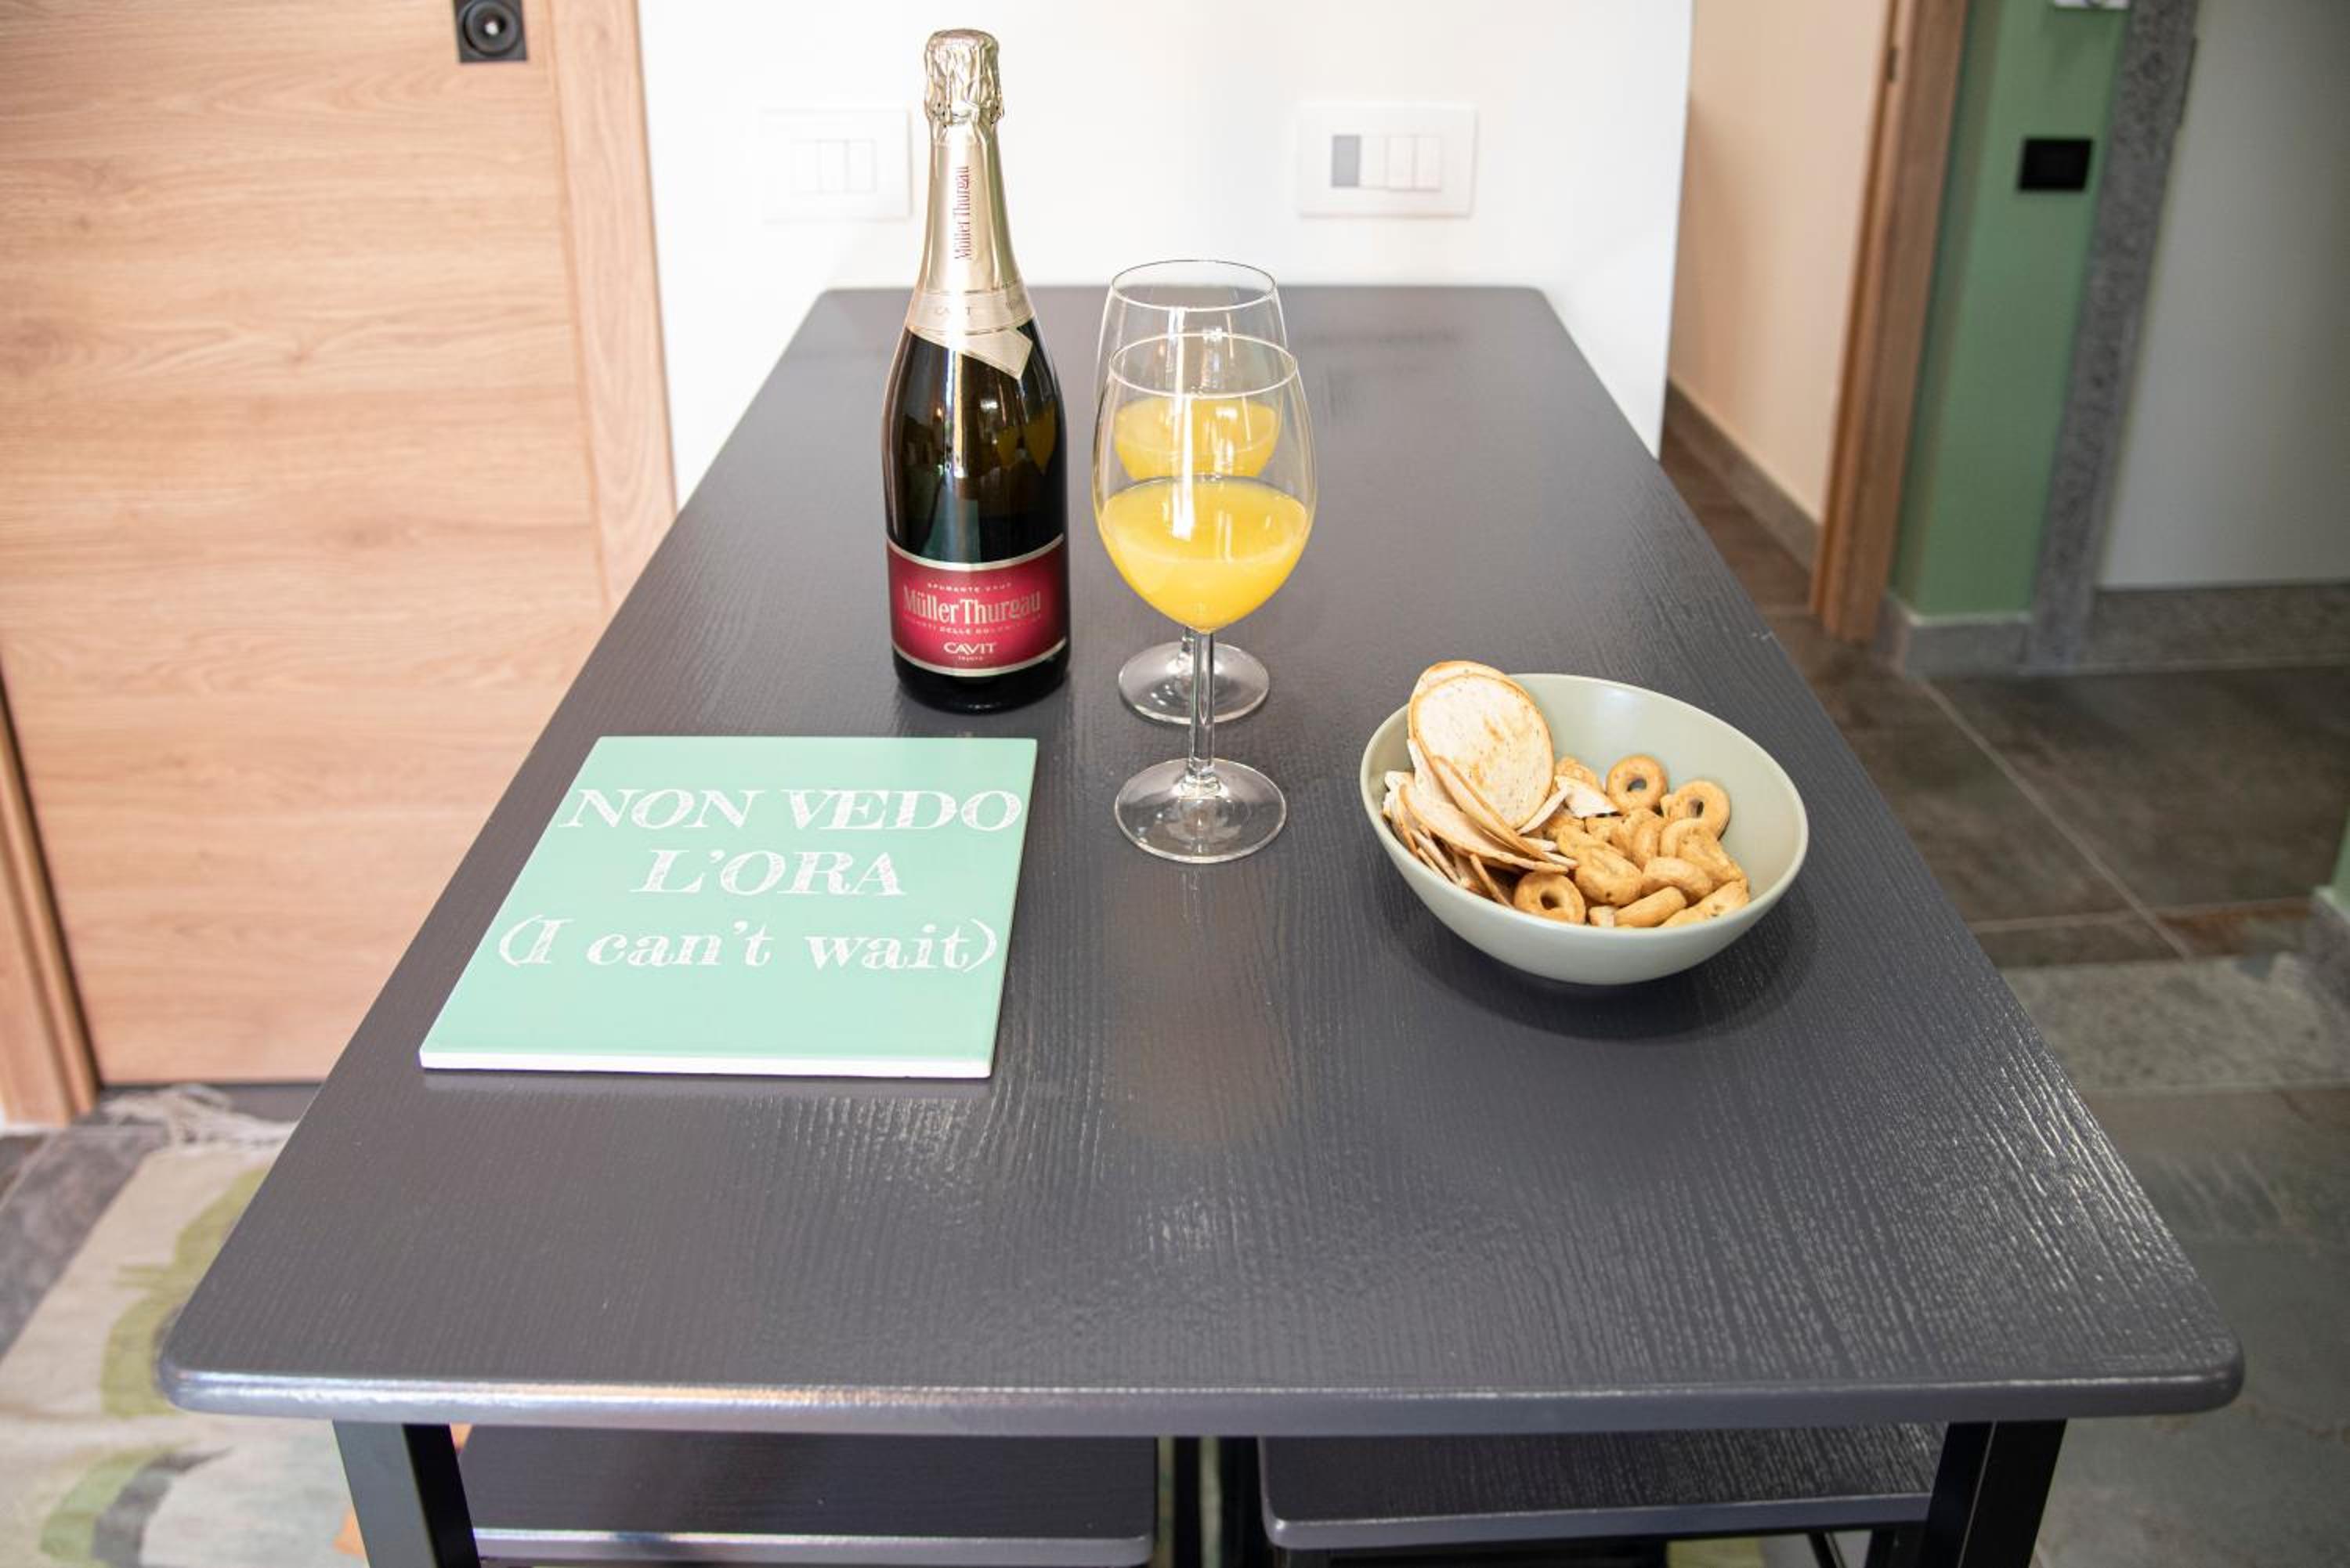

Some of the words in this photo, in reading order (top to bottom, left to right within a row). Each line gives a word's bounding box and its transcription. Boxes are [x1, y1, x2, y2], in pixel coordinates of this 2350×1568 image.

[903, 585, 959, 623] Müller
[960, 591, 1041, 624] Thurgau
[943, 641, 997, 656] CAVIT
[557, 788, 765, 829] NON
[780, 789, 1022, 831] VEDO
[629, 849, 906, 895] L'ORA
[498, 914, 573, 966] (I
[586, 919, 776, 967] can't
[804, 918, 997, 972] wait)
